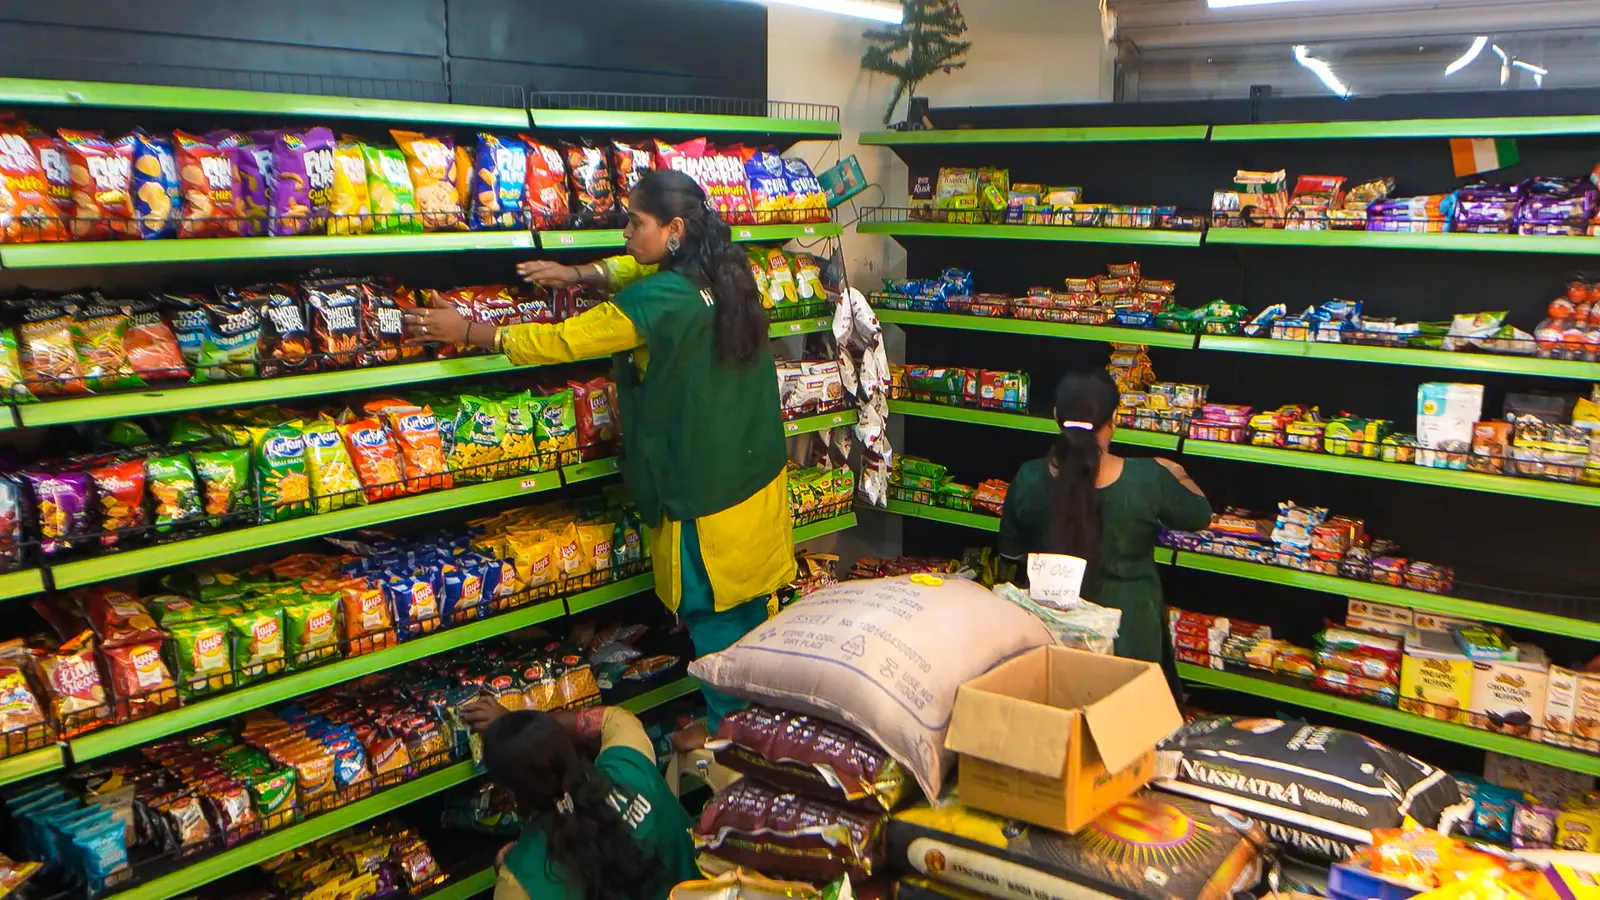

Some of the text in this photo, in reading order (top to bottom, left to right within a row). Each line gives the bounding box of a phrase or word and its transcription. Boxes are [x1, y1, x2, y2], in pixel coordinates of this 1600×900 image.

[914, 183, 931, 193] Rusk
[1181, 757, 1369, 818] NAKSHATRA Kolam Rice
